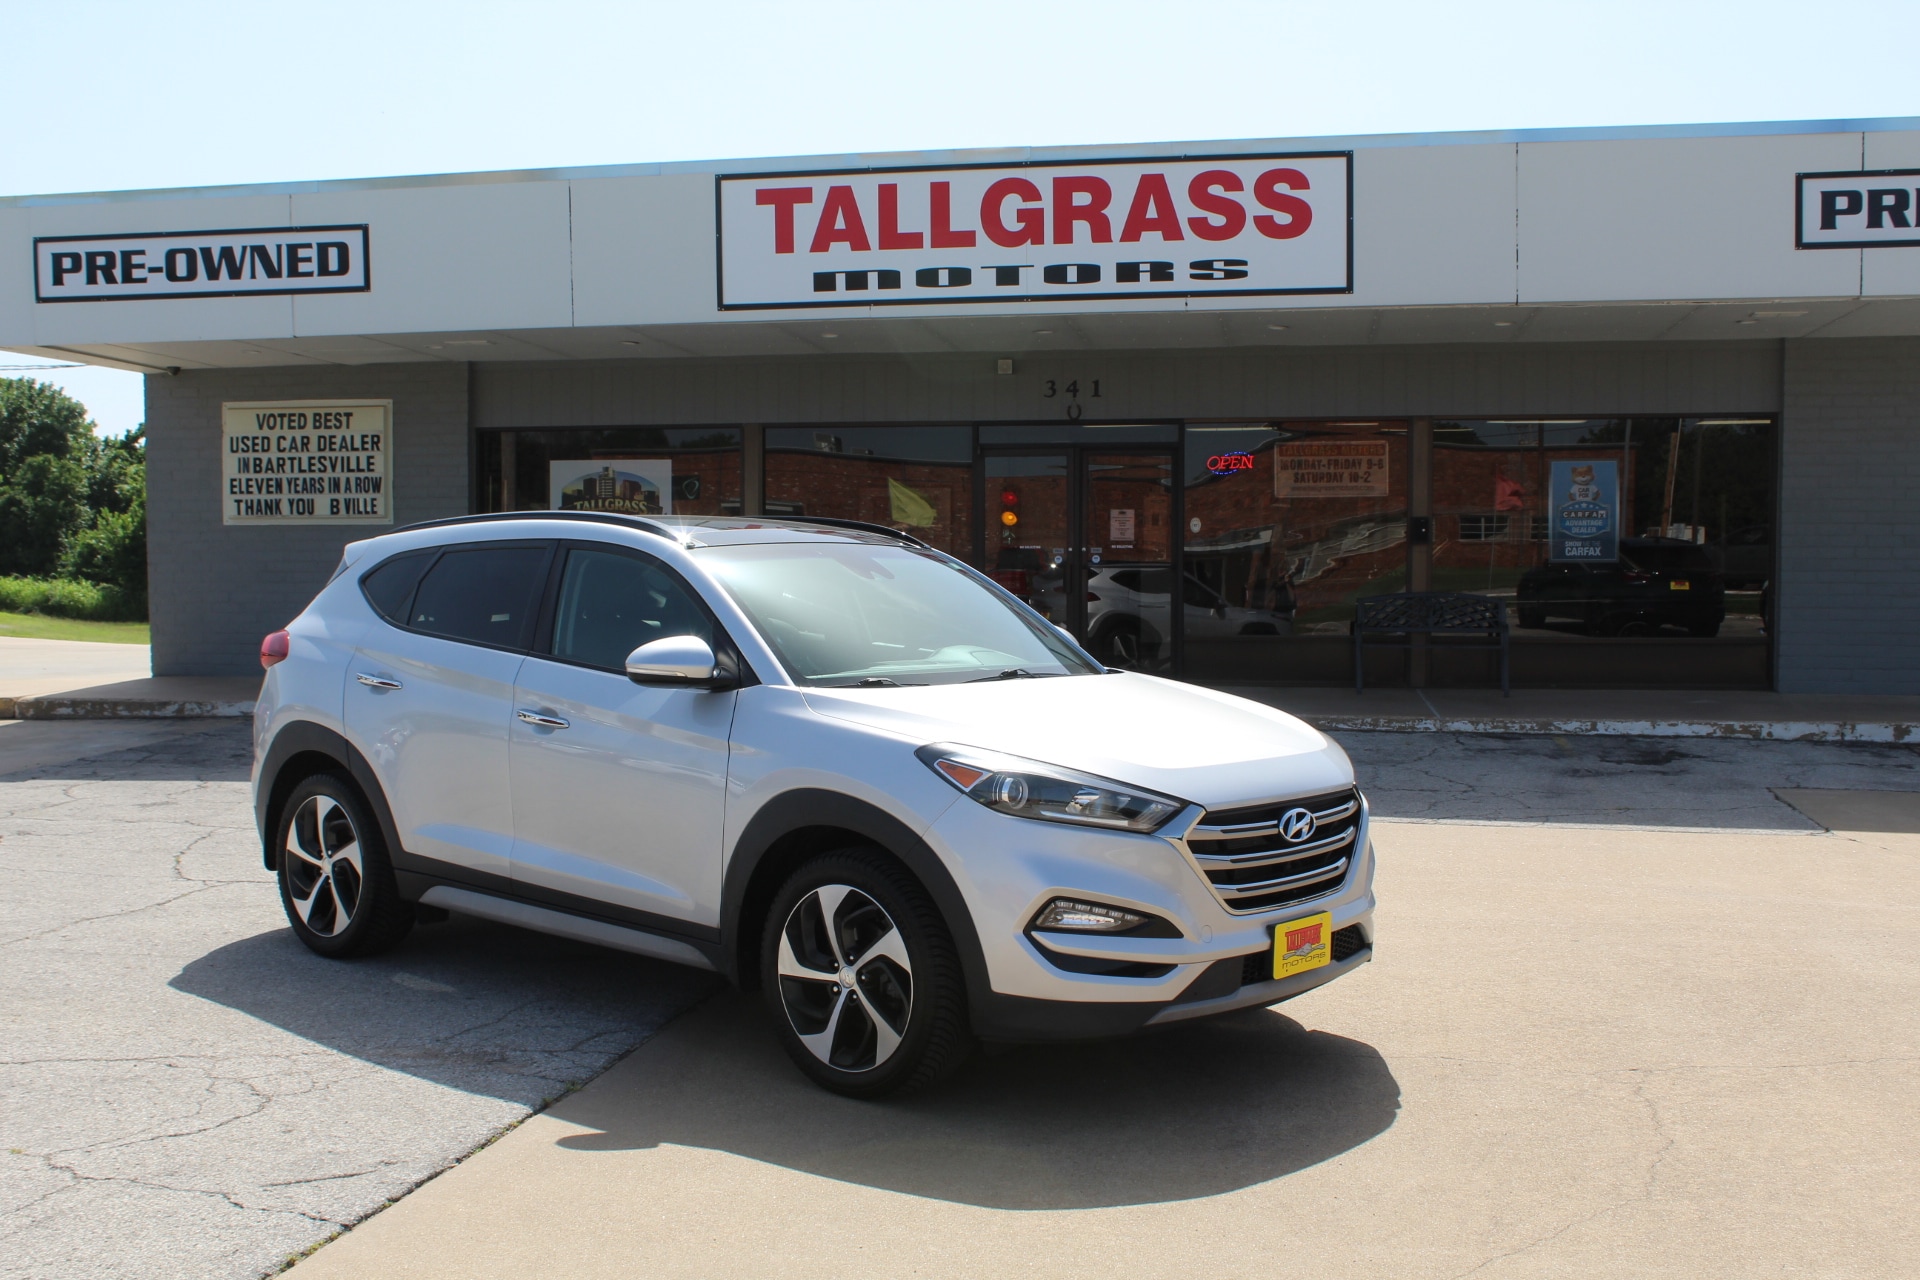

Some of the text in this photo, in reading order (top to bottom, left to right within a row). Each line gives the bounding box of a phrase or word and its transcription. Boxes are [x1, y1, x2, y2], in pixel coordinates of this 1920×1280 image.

[754, 167, 1313, 255] TALLGRASS
[1819, 187, 1920, 231] PR
[50, 240, 350, 287] PRE-OWNED
[812, 258, 1249, 293] MOTORS
[1043, 379, 1102, 398] 341
[256, 412, 354, 431] VOTED BEST
[230, 434, 381, 453] USED CAR DEALER
[237, 455, 376, 474] IN BARTLESVILLE
[1206, 454, 1255, 471] OPEN
[229, 475, 382, 495] ELEVEN YEARS IN A ROW
[1293, 471, 1371, 484] SATURDAY 10-2
[234, 497, 378, 516] THANK YOU B VILLE
[574, 498, 648, 514] TALLGRASS
[1571, 526, 1597, 534] DEALER
[1565, 547, 1601, 556] CARFAX
[1282, 951, 1326, 969] MOTORS
